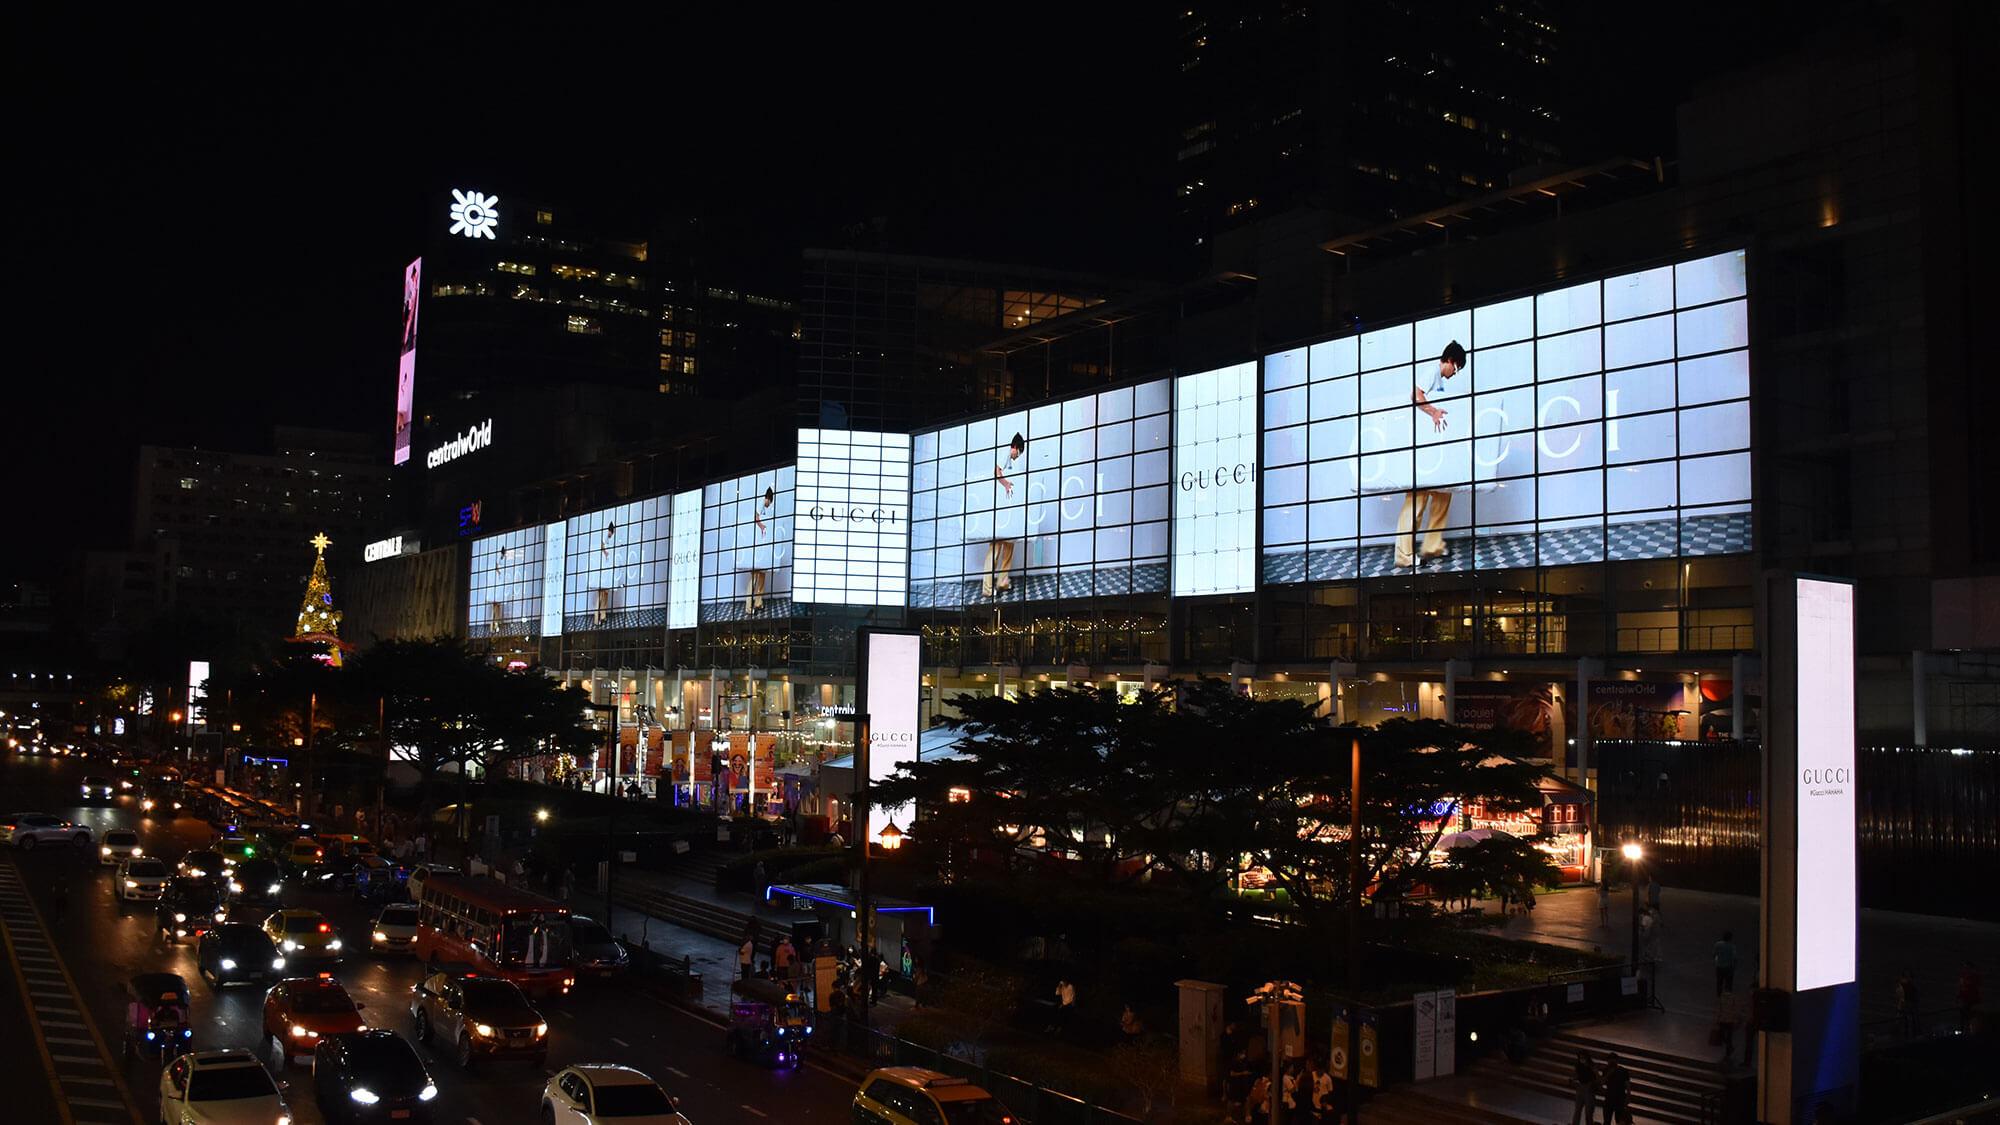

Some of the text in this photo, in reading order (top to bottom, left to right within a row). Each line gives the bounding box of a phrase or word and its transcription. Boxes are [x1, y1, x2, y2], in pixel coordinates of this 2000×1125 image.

[1180, 462, 1256, 492] GUCCI
[809, 505, 896, 525] GUCCI
[1595, 684, 1656, 696] centralwOrld
[871, 732, 913, 742] GUCCI
[1803, 768, 1850, 785] GUCCI
